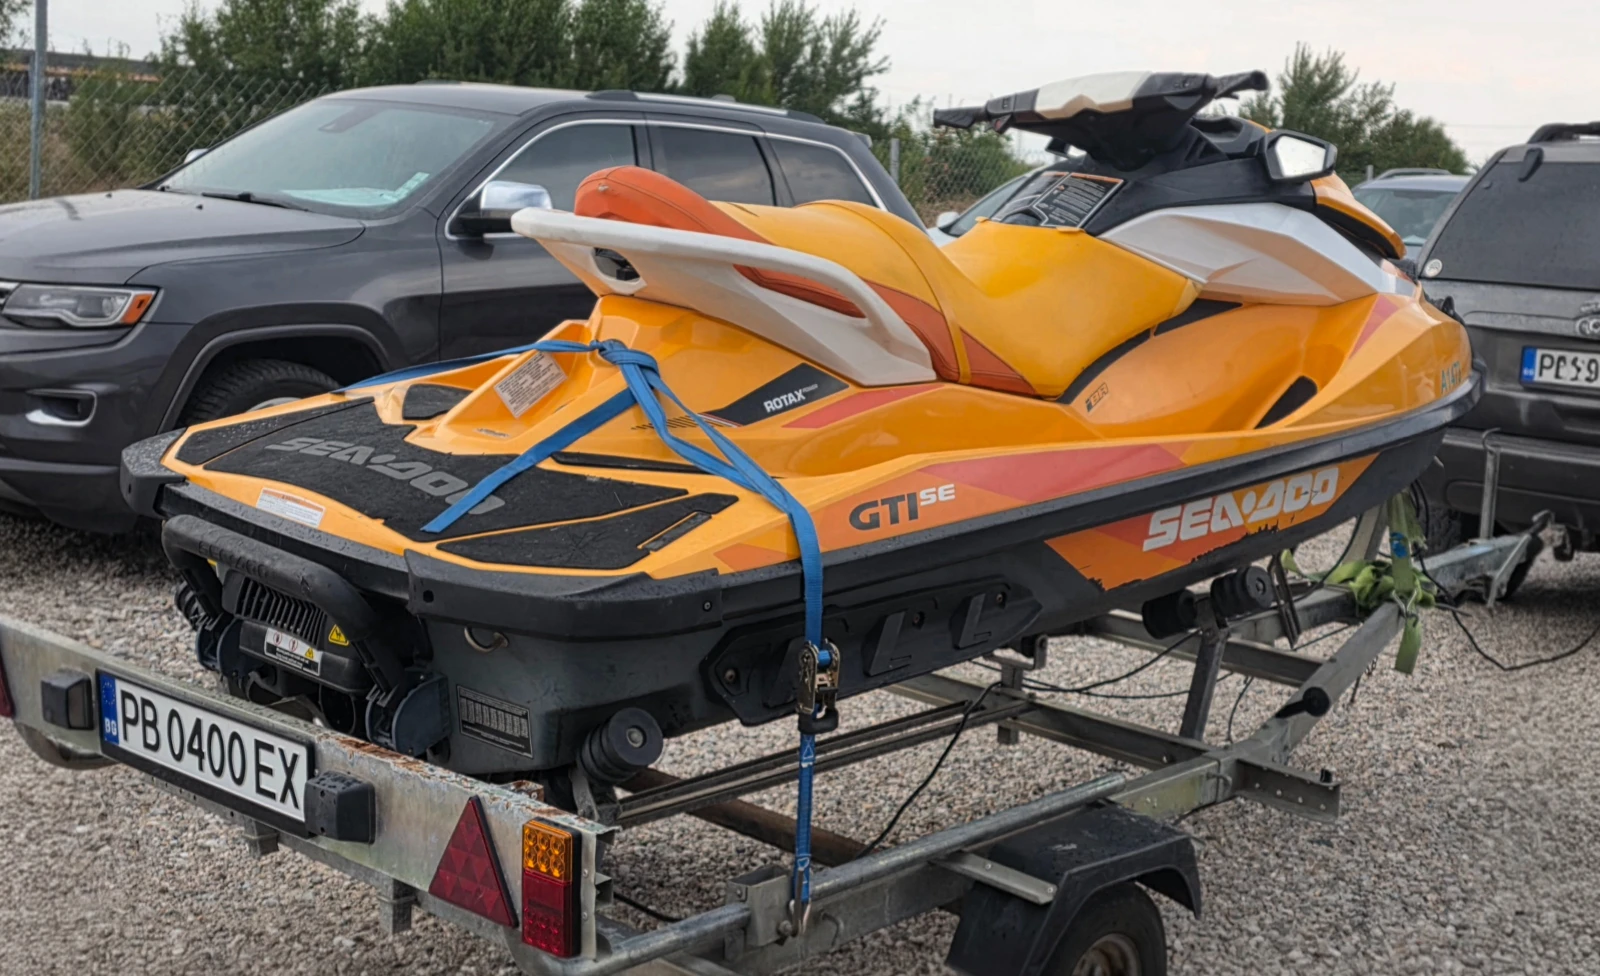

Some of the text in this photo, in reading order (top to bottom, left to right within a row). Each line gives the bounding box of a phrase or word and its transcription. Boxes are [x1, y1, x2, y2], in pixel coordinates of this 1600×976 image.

[763, 388, 806, 413] ROTAX
[849, 483, 956, 531] GTI SE
[104, 717, 117, 736] BG
[120, 689, 299, 810] PB 0400 EX
